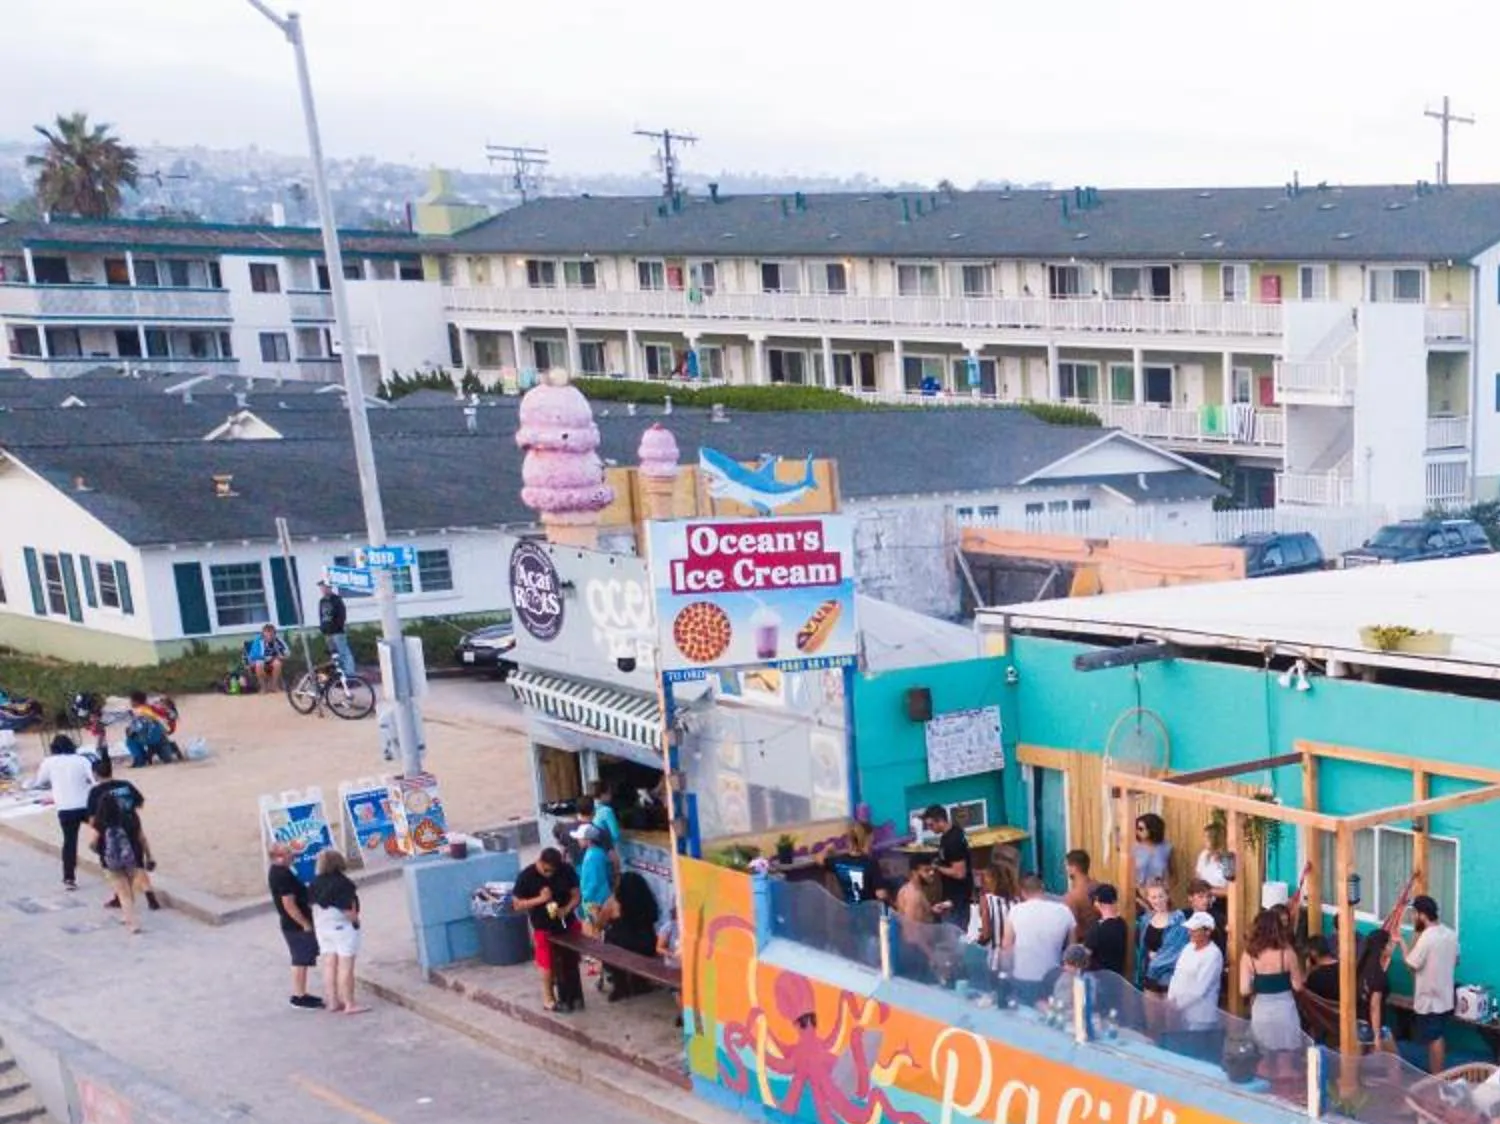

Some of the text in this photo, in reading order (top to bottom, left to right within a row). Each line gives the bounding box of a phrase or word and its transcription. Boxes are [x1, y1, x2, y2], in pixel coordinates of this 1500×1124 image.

[690, 525, 820, 557] Ocean's
[673, 559, 838, 592] Ice Cream
